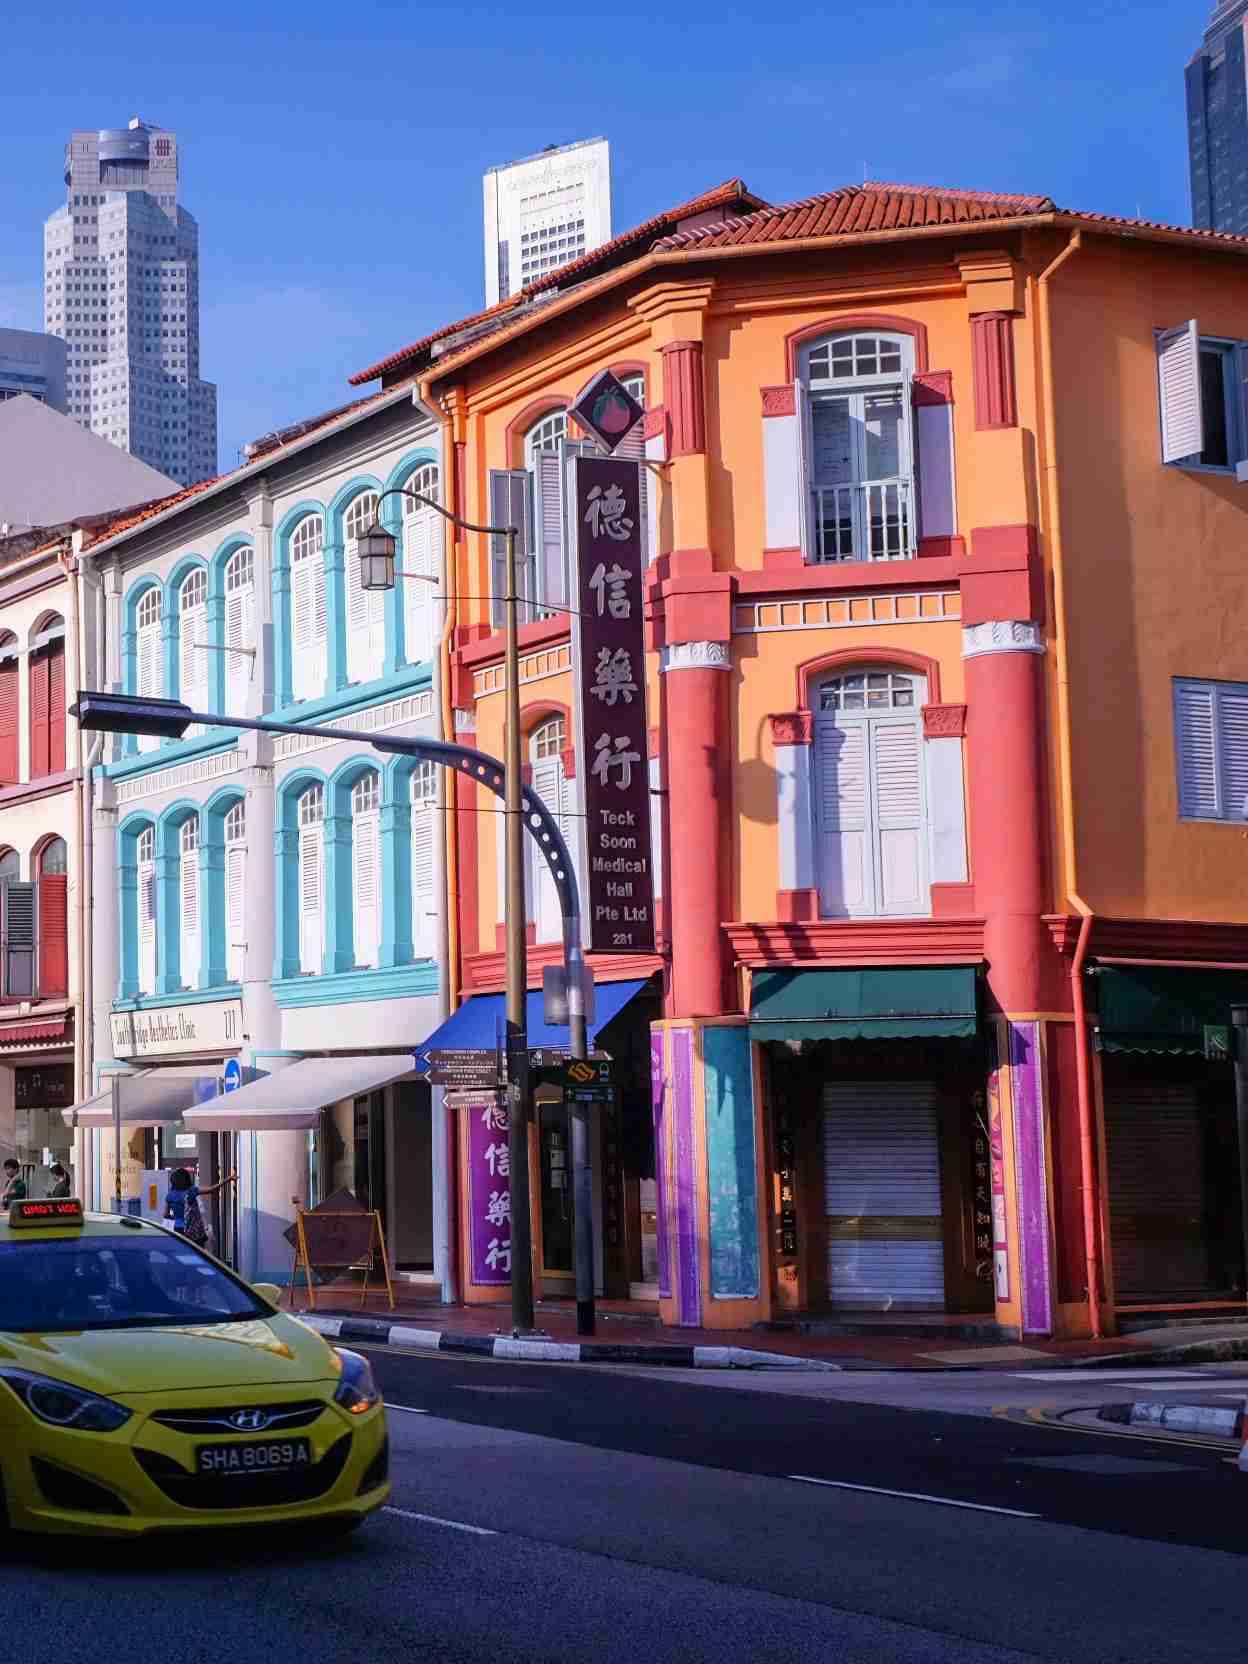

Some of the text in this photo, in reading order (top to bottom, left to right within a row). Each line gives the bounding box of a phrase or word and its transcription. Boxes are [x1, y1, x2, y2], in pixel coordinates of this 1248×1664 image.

[600, 810, 635, 827] Teck
[600, 832, 637, 849] Soon
[593, 856, 646, 875] Medical
[606, 881, 633, 898] Hall
[595, 906, 648, 922] Pte Ltd
